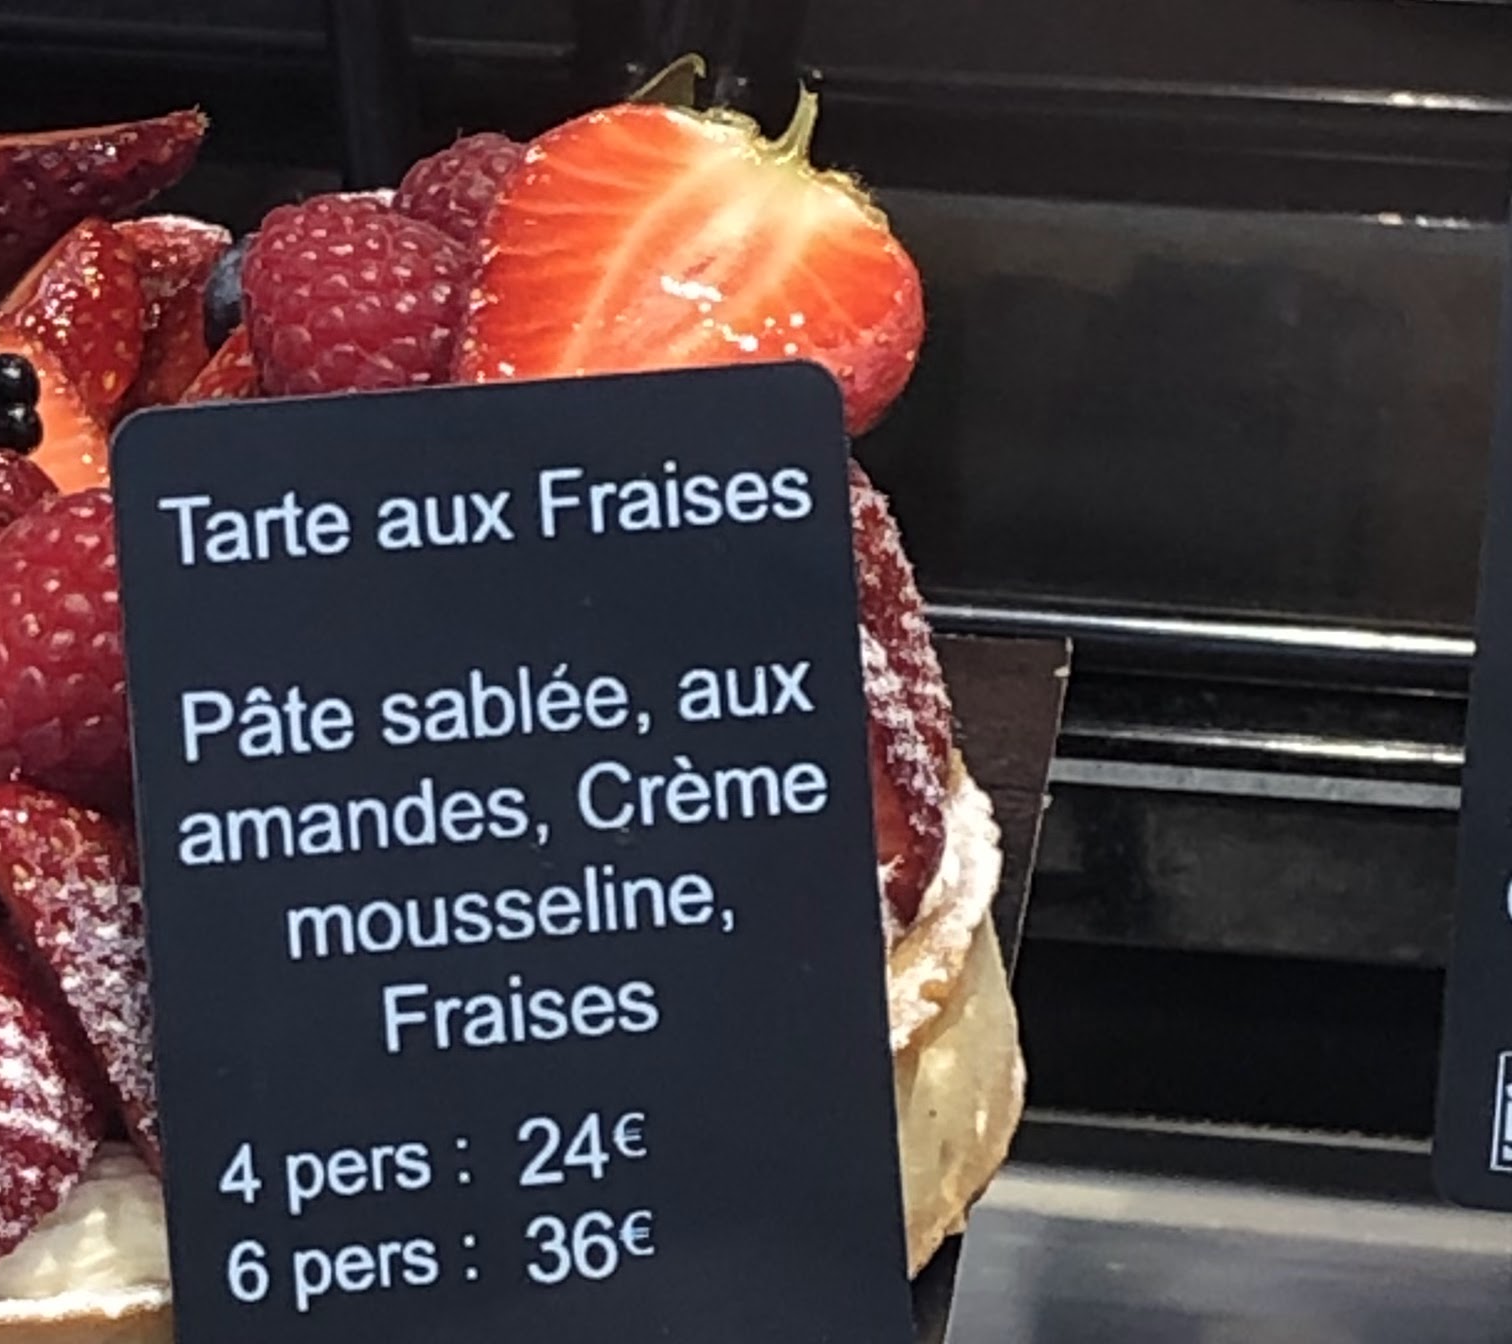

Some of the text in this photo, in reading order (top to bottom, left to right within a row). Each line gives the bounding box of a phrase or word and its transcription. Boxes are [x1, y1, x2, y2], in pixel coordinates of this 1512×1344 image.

[158, 460, 814, 565] Tarte aux Fraises
[181, 660, 816, 762] Pâte sablée, aux
[178, 755, 829, 866] amandes, Crème
[286, 863, 736, 960] mousseline,
[382, 974, 660, 1054] Fraises
[219, 1142, 263, 1204] 4
[285, 1140, 433, 1216] pers
[516, 1111, 649, 1186] 24€
[227, 1239, 270, 1303] 6
[292, 1236, 440, 1313] pers
[524, 1210, 656, 1285] 36€
